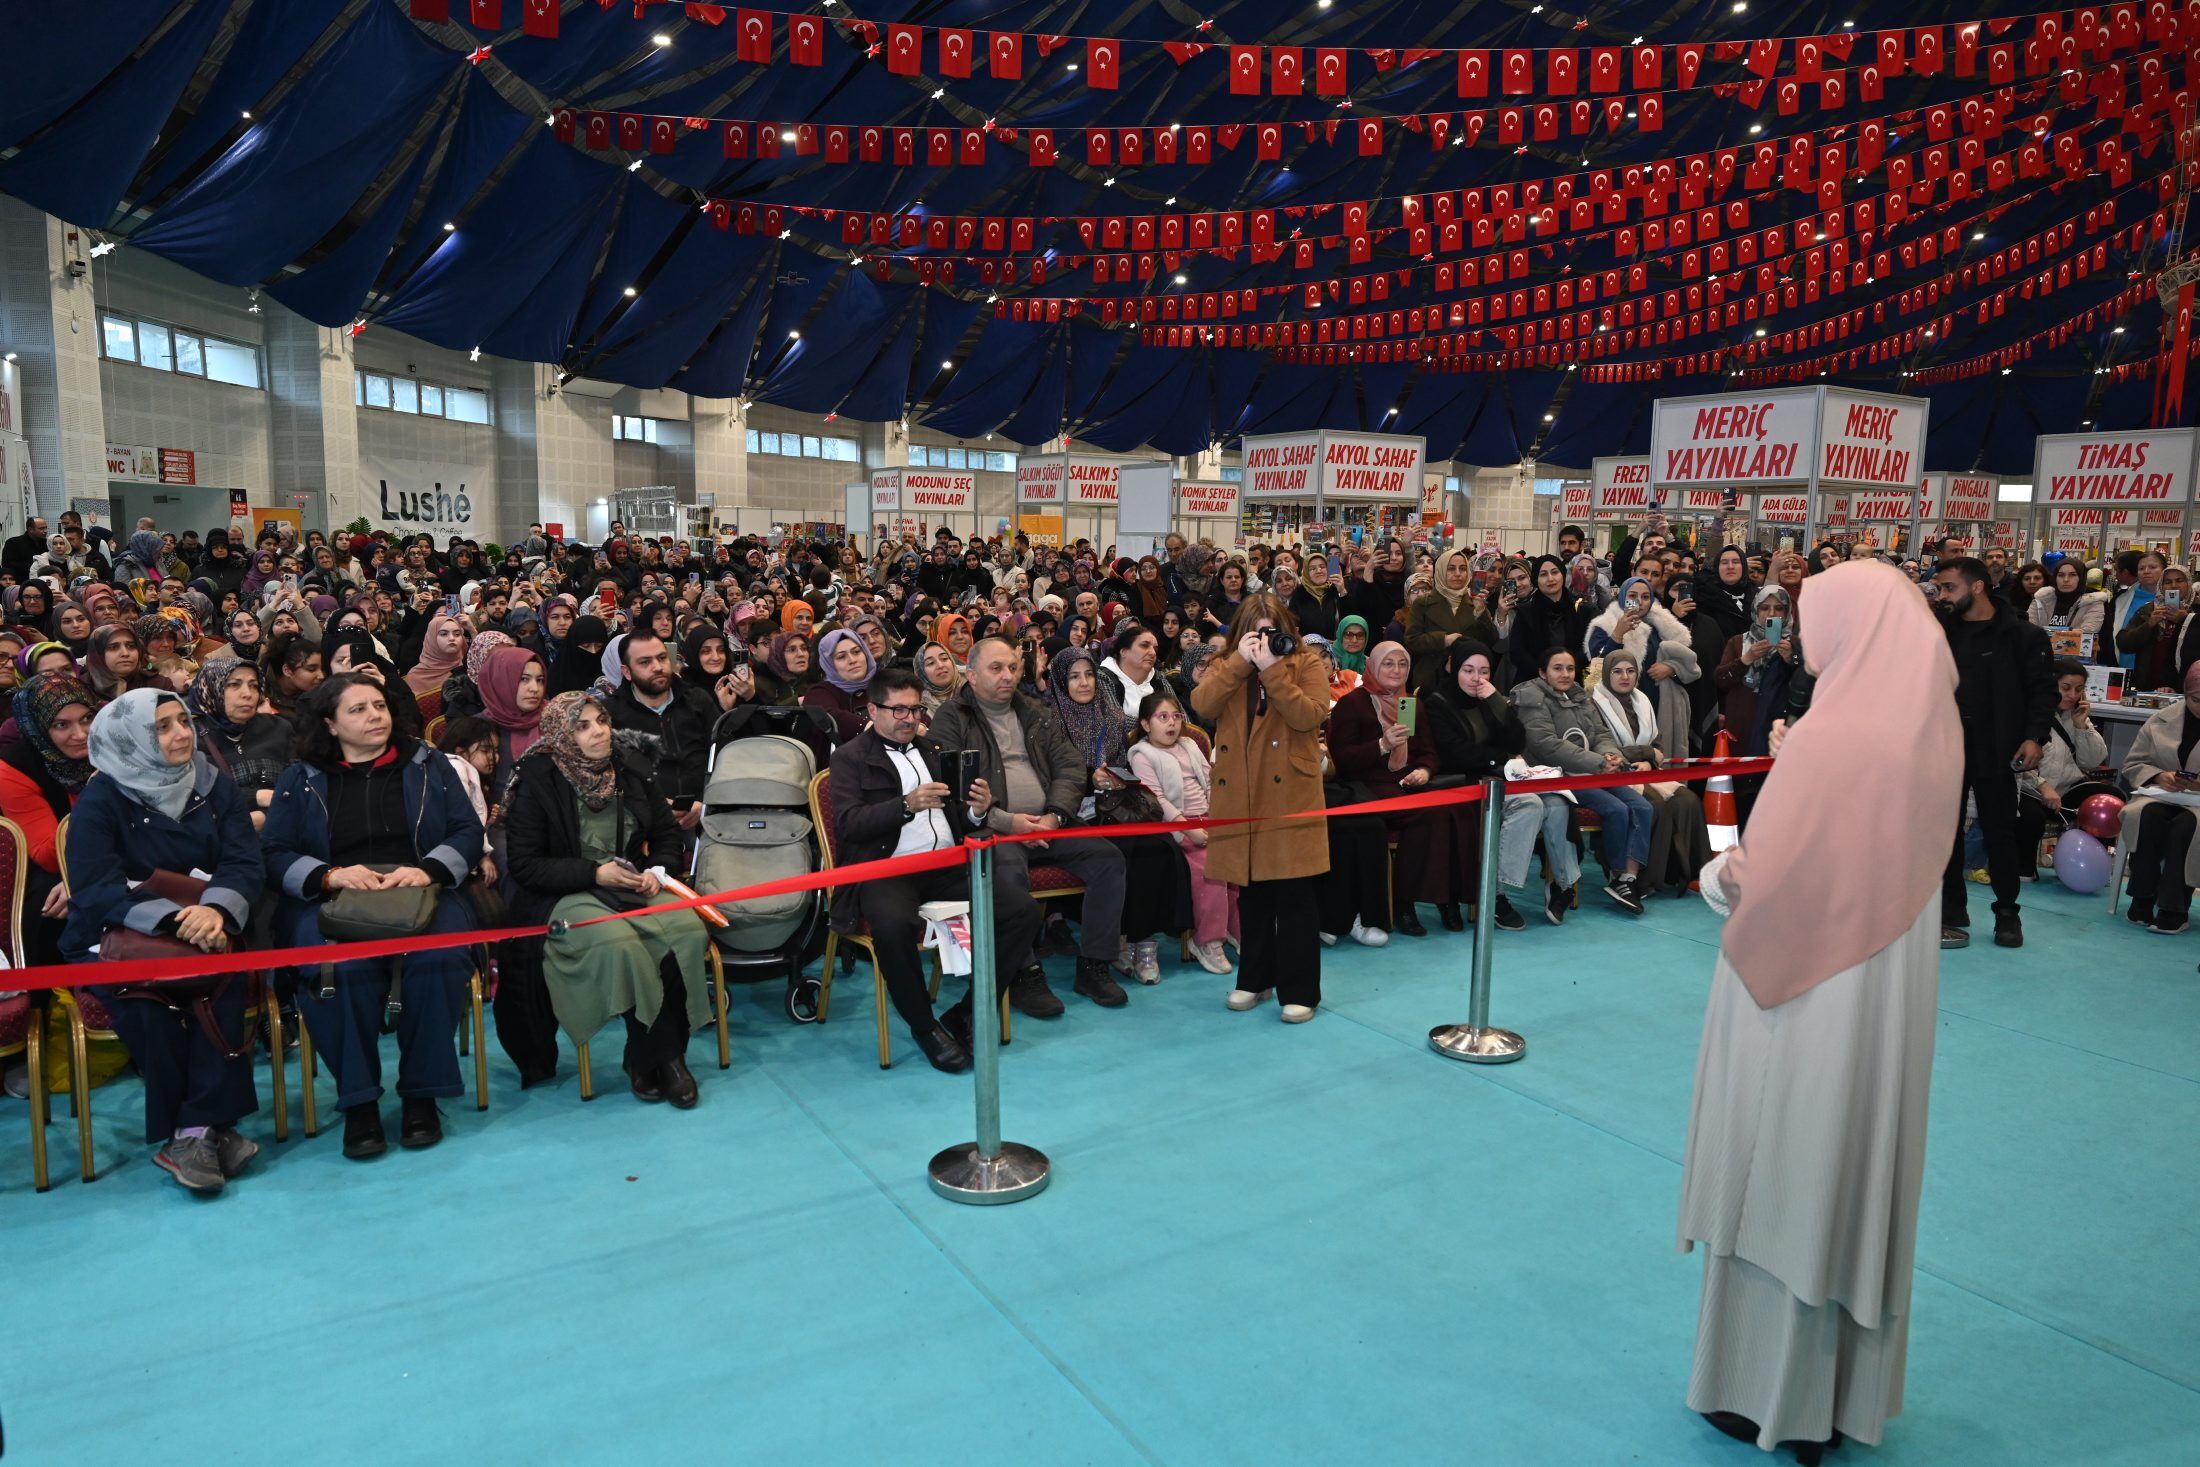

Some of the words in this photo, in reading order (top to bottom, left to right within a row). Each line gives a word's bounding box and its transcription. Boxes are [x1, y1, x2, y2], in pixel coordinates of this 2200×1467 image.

[113, 448, 131, 456] BAYAN
[1247, 448, 1279, 468] AKYOL
[1282, 444, 1317, 466] SAHAF
[1325, 443, 1369, 465] AKYOL
[1373, 447, 1417, 468] SAHAF
[107, 460, 126, 473] WC
[1665, 443, 1798, 480] YAYINLARI
[1823, 443, 1910, 483] YAYINLARI
[1018, 467, 1041, 482] SALKIM
[1041, 464, 1064, 481] SÖĞÜT
[1068, 465, 1111, 481] SALKIM
[1254, 470, 1308, 490] YAYINLARI
[1336, 469, 1405, 491] YAYINLARI
[873, 476, 891, 489] MODUNU
[891, 475, 900, 490] SEÇ
[906, 476, 951, 489] MODUNU
[953, 477, 973, 492] SEÇ
[2050, 473, 2173, 500] YAYINLARI
[876, 493, 896, 504] YAYINLARI
[914, 492, 965, 505] YAYINLARI
[1024, 484, 1057, 499] YAYINLARI
[1080, 484, 1118, 500] YAYINL
[1208, 487, 1236, 500] ŞEYLER
[1601, 487, 1668, 506] YAYINLRI
[1689, 490, 1744, 507] YAYINRI
[380, 480, 471, 523] Lushé
[1187, 500, 1229, 513] YAYINLARI
[1761, 500, 1780, 510] ADA
[1945, 501, 1991, 519] YAYINLARI
[2145, 510, 2180, 523] YAYINLARI
